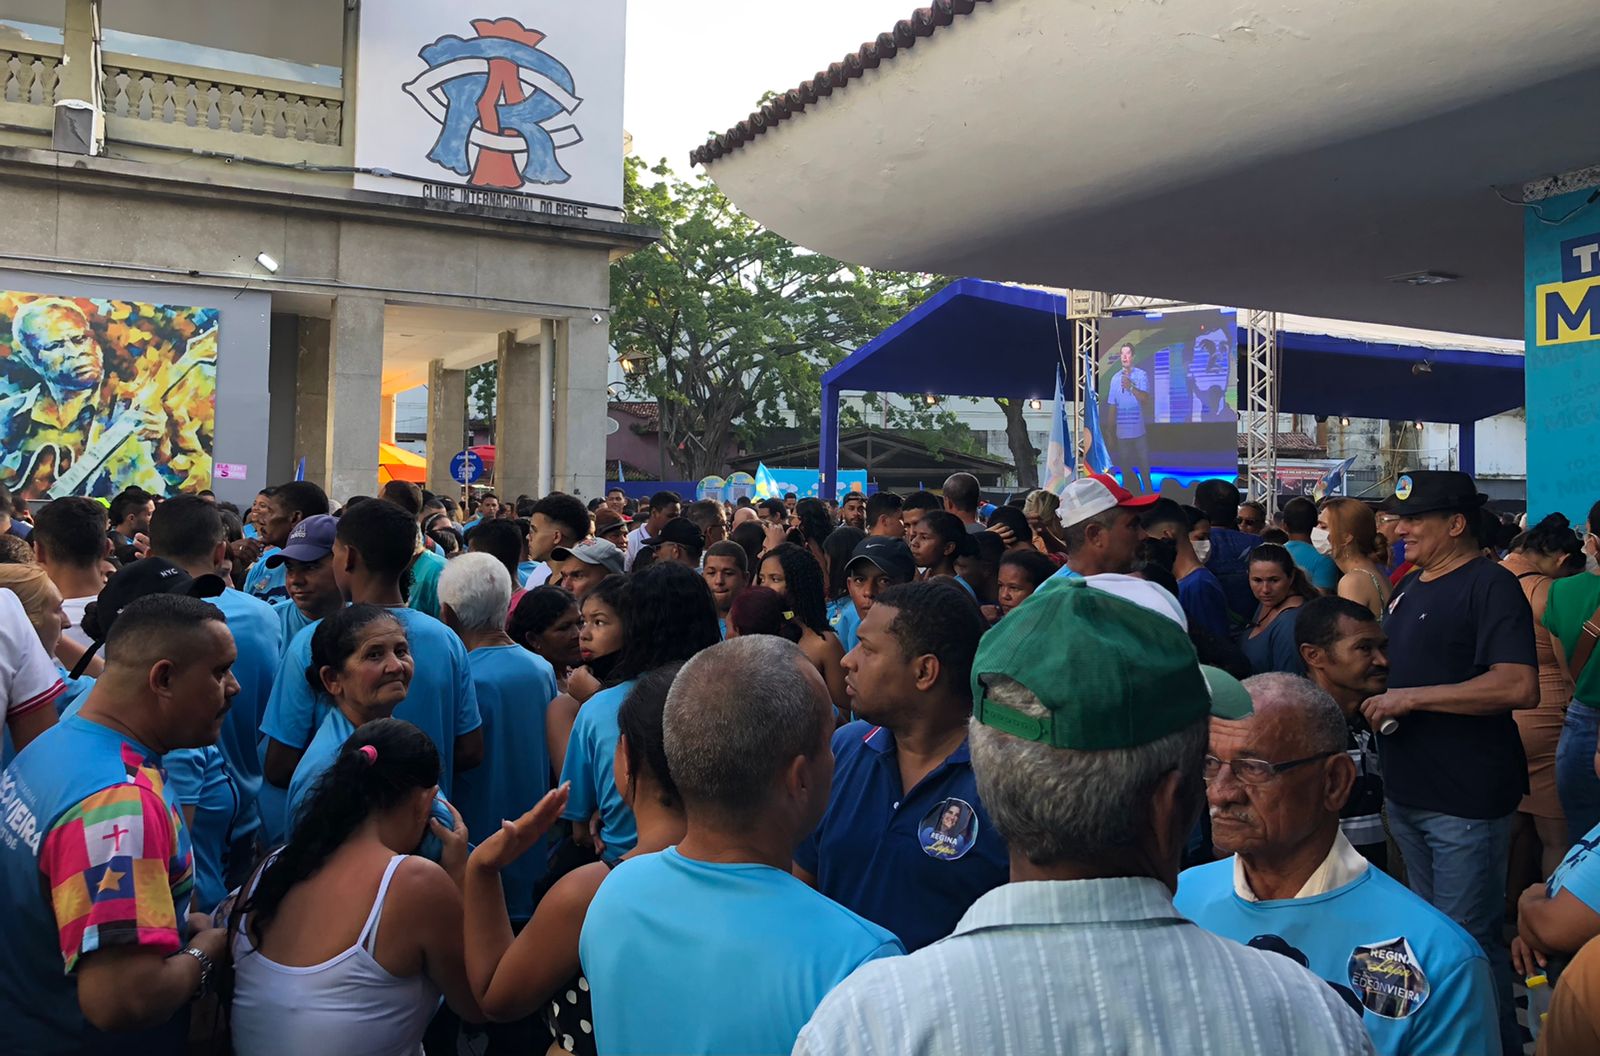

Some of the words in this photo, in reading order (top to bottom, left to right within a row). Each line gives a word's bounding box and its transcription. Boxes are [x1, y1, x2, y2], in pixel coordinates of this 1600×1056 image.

[422, 184, 455, 201] CLUBE
[460, 188, 535, 211] INTERNACIONAL
[540, 200, 553, 213] DO
[556, 202, 589, 218] RECIFE
[1572, 243, 1600, 273] T
[930, 832, 958, 845] REGINA
[1370, 949, 1410, 964] REGIN
